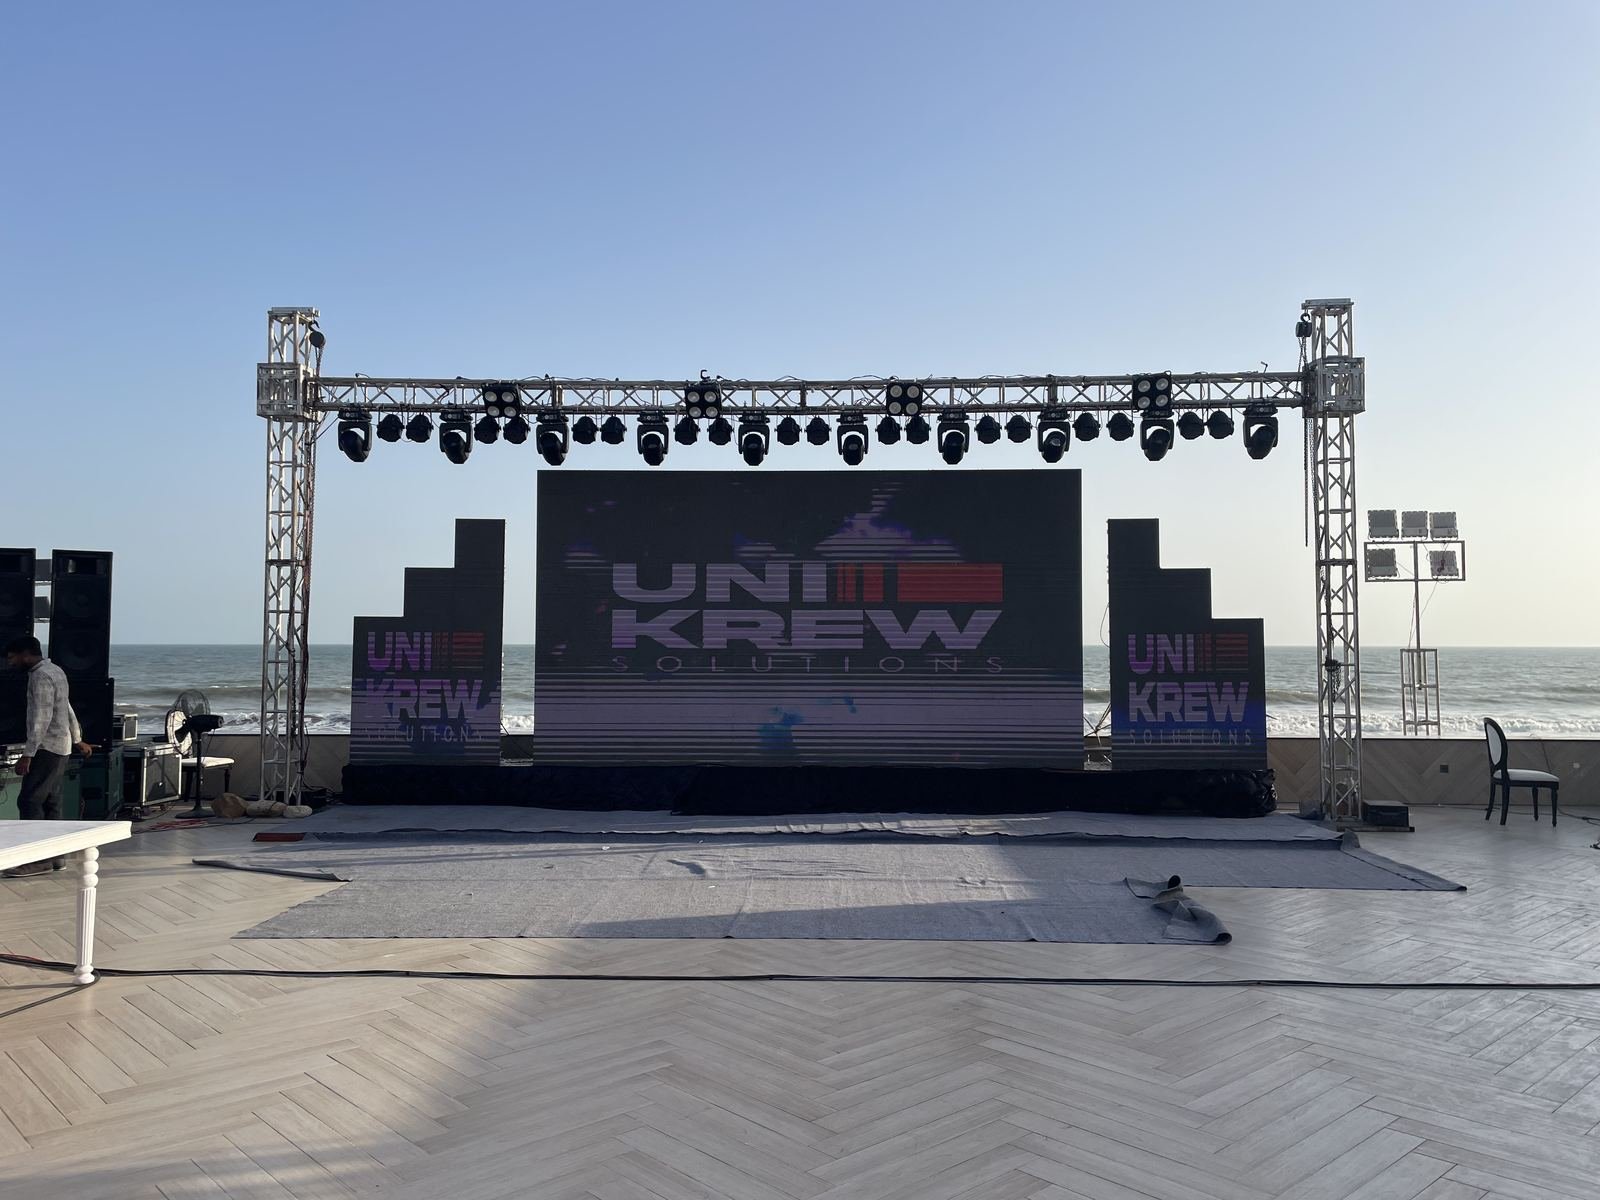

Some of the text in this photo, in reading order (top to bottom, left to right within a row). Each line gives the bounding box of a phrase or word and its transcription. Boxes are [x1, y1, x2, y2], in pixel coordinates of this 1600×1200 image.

[612, 562, 828, 603] UNI
[612, 609, 1003, 650] KREW
[367, 631, 432, 671] UNI
[612, 655, 1004, 673] SOLUTIONS
[1127, 633, 1195, 674] UNI
[366, 678, 483, 719] KREW
[1128, 681, 1250, 722] KREW
[1129, 728, 1253, 746] SOLUTIONS
